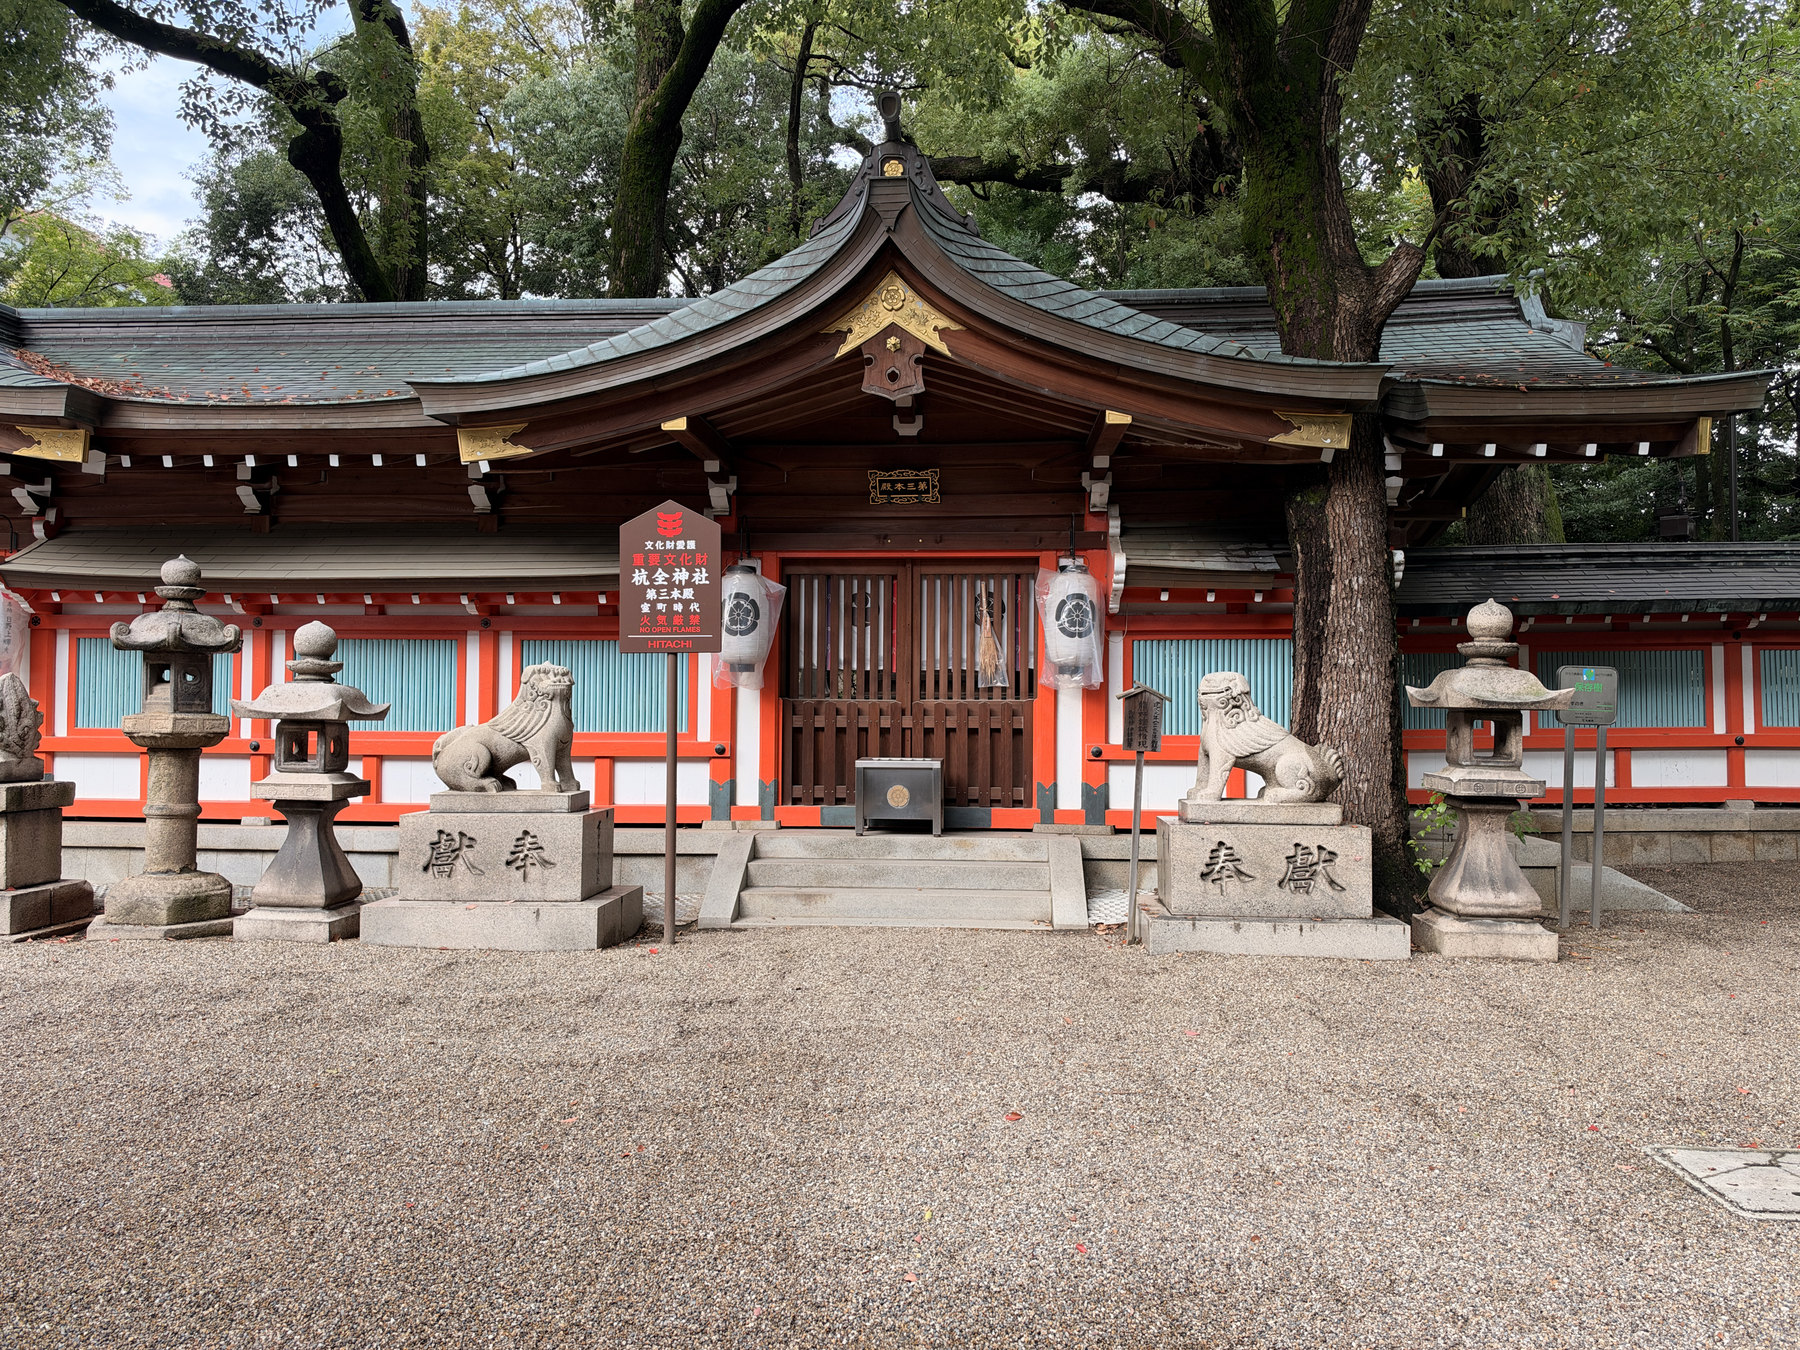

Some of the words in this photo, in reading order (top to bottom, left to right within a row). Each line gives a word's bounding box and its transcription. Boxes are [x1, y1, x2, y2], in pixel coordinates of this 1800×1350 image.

[644, 540, 697, 550] 文化財愛護
[631, 552, 709, 567] 重要文化財
[630, 567, 710, 586] 杭全神社
[645, 588, 695, 601] 第三本殿
[640, 602, 701, 613] 室町時代
[639, 614, 701, 626] 火気厳禁
[647, 640, 693, 649] HITACHI
